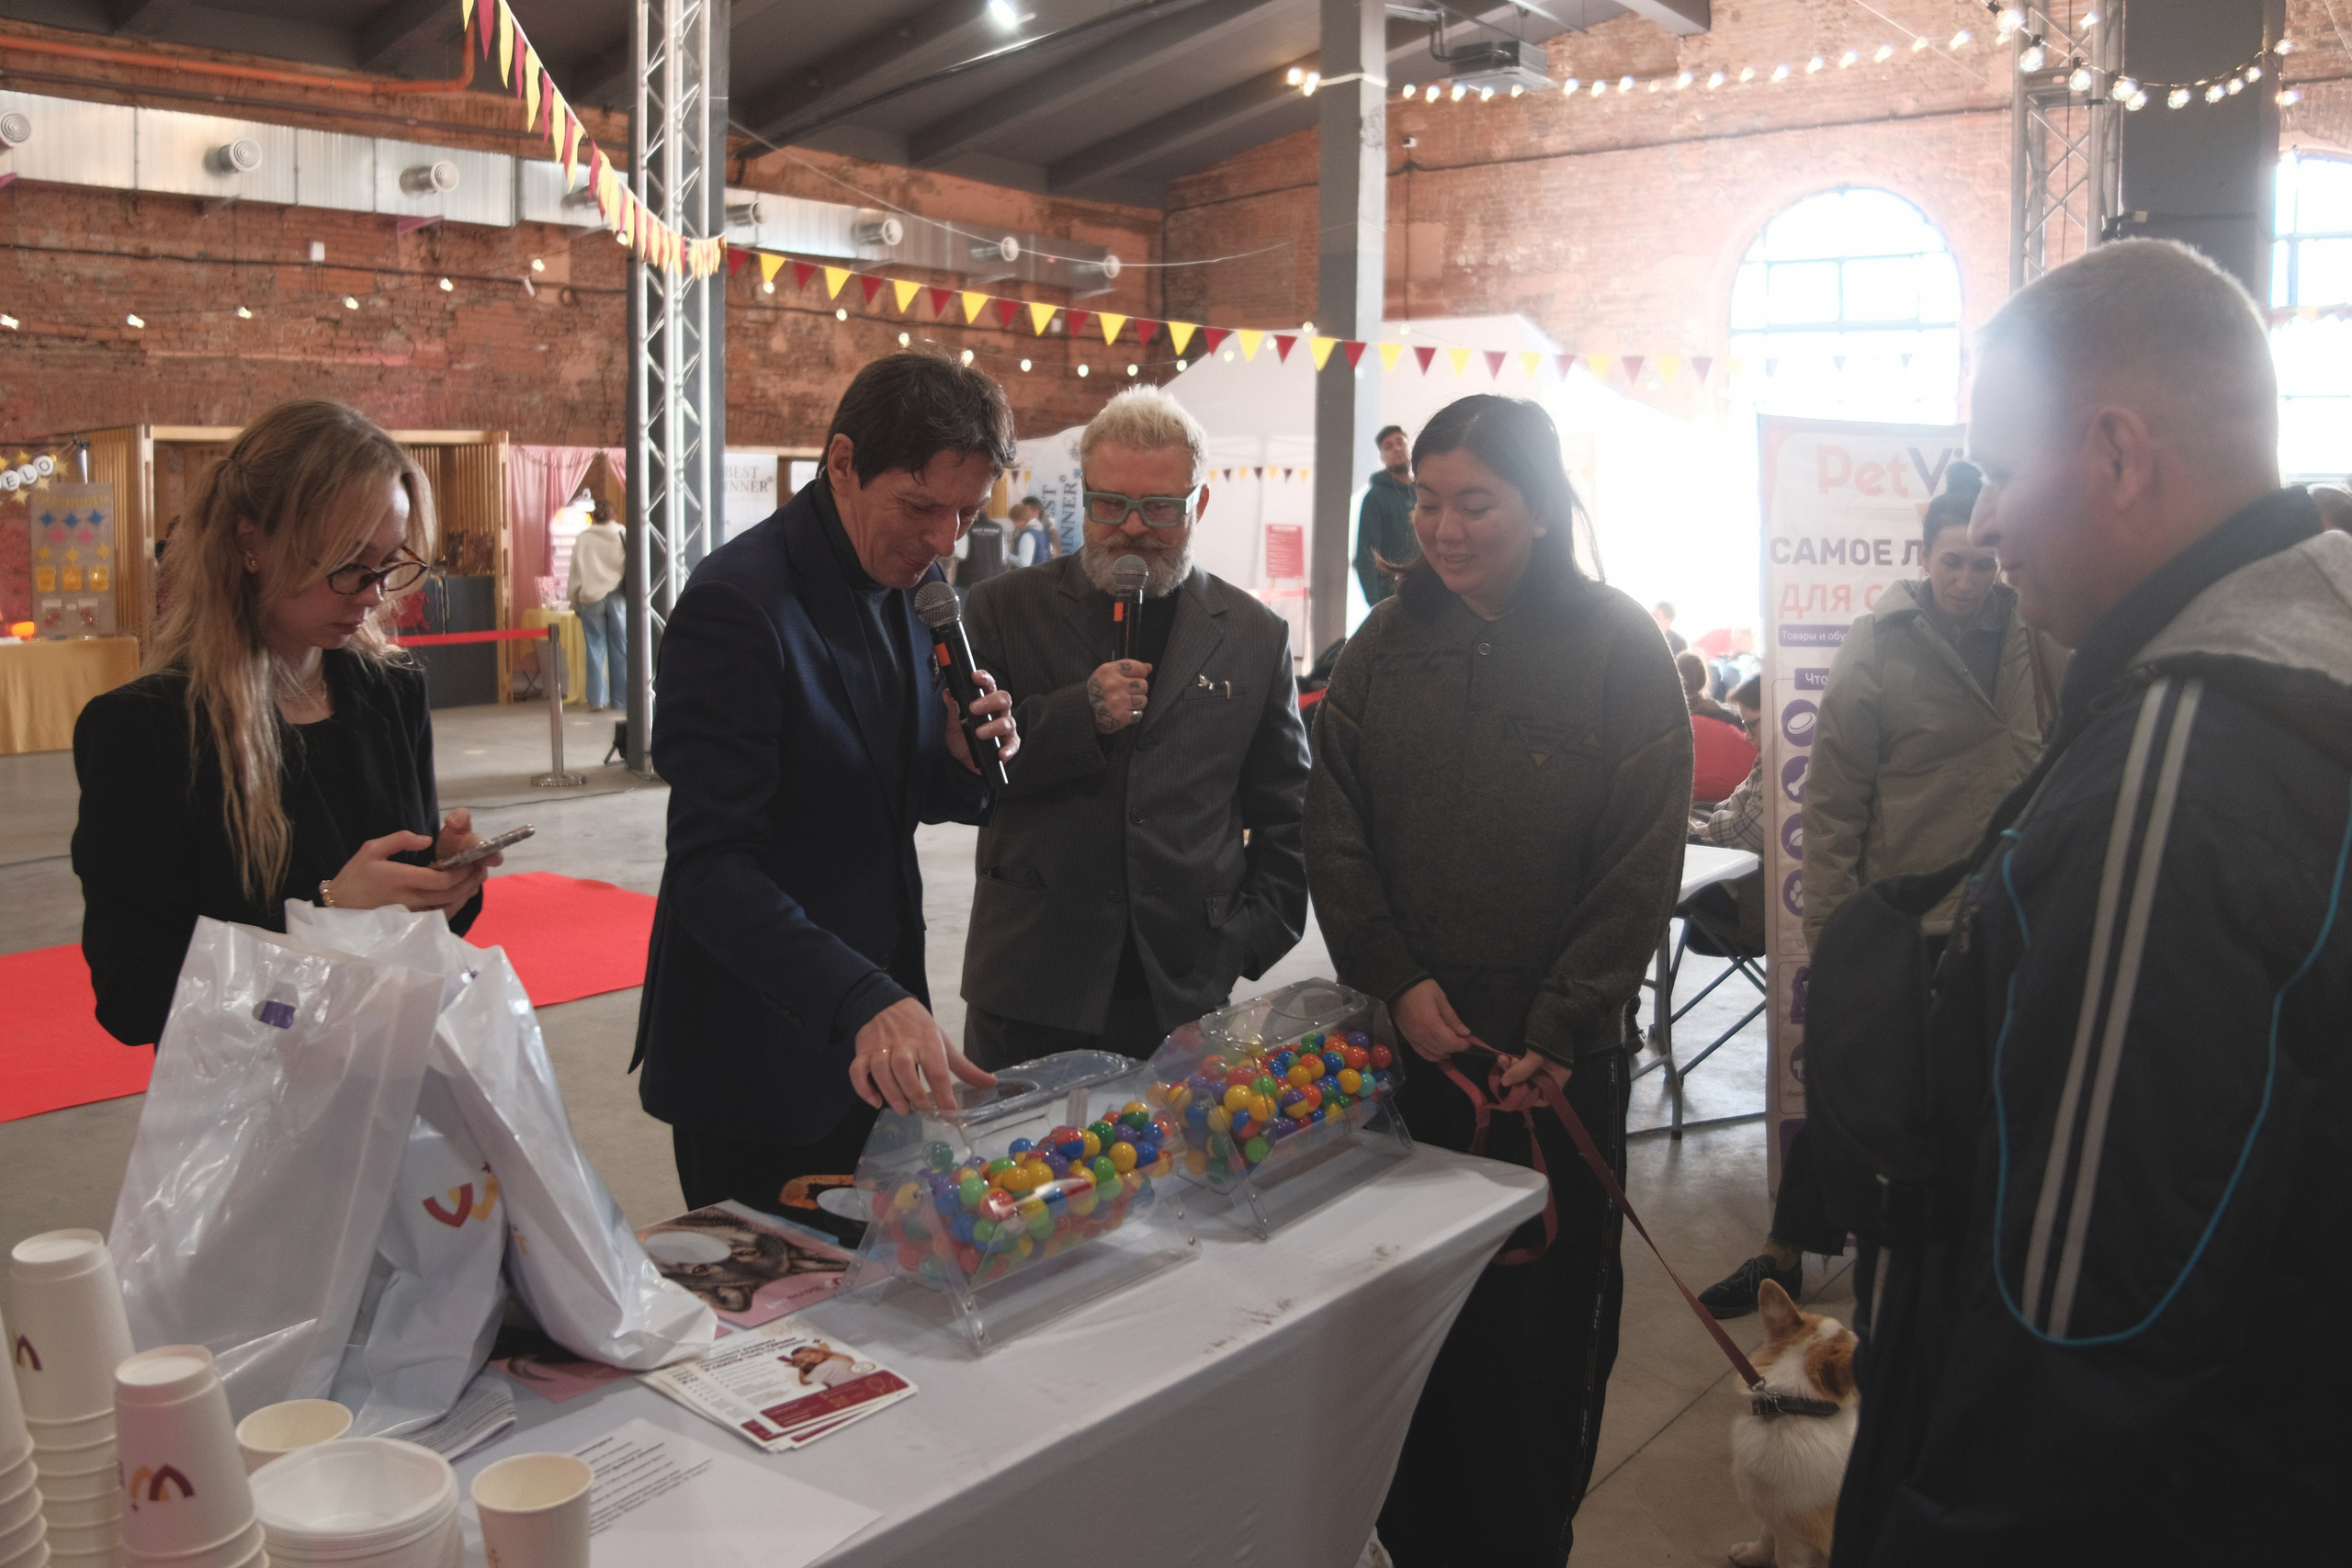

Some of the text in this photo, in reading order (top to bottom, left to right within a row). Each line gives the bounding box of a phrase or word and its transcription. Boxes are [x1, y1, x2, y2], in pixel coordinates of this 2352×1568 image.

[1770, 536, 1893, 566] САМОЕ
[1779, 583, 1850, 619] ДЛЯ
[1782, 630, 1816, 641] Товары
[1819, 632, 1826, 640] и
[1805, 672, 1828, 685] Что
